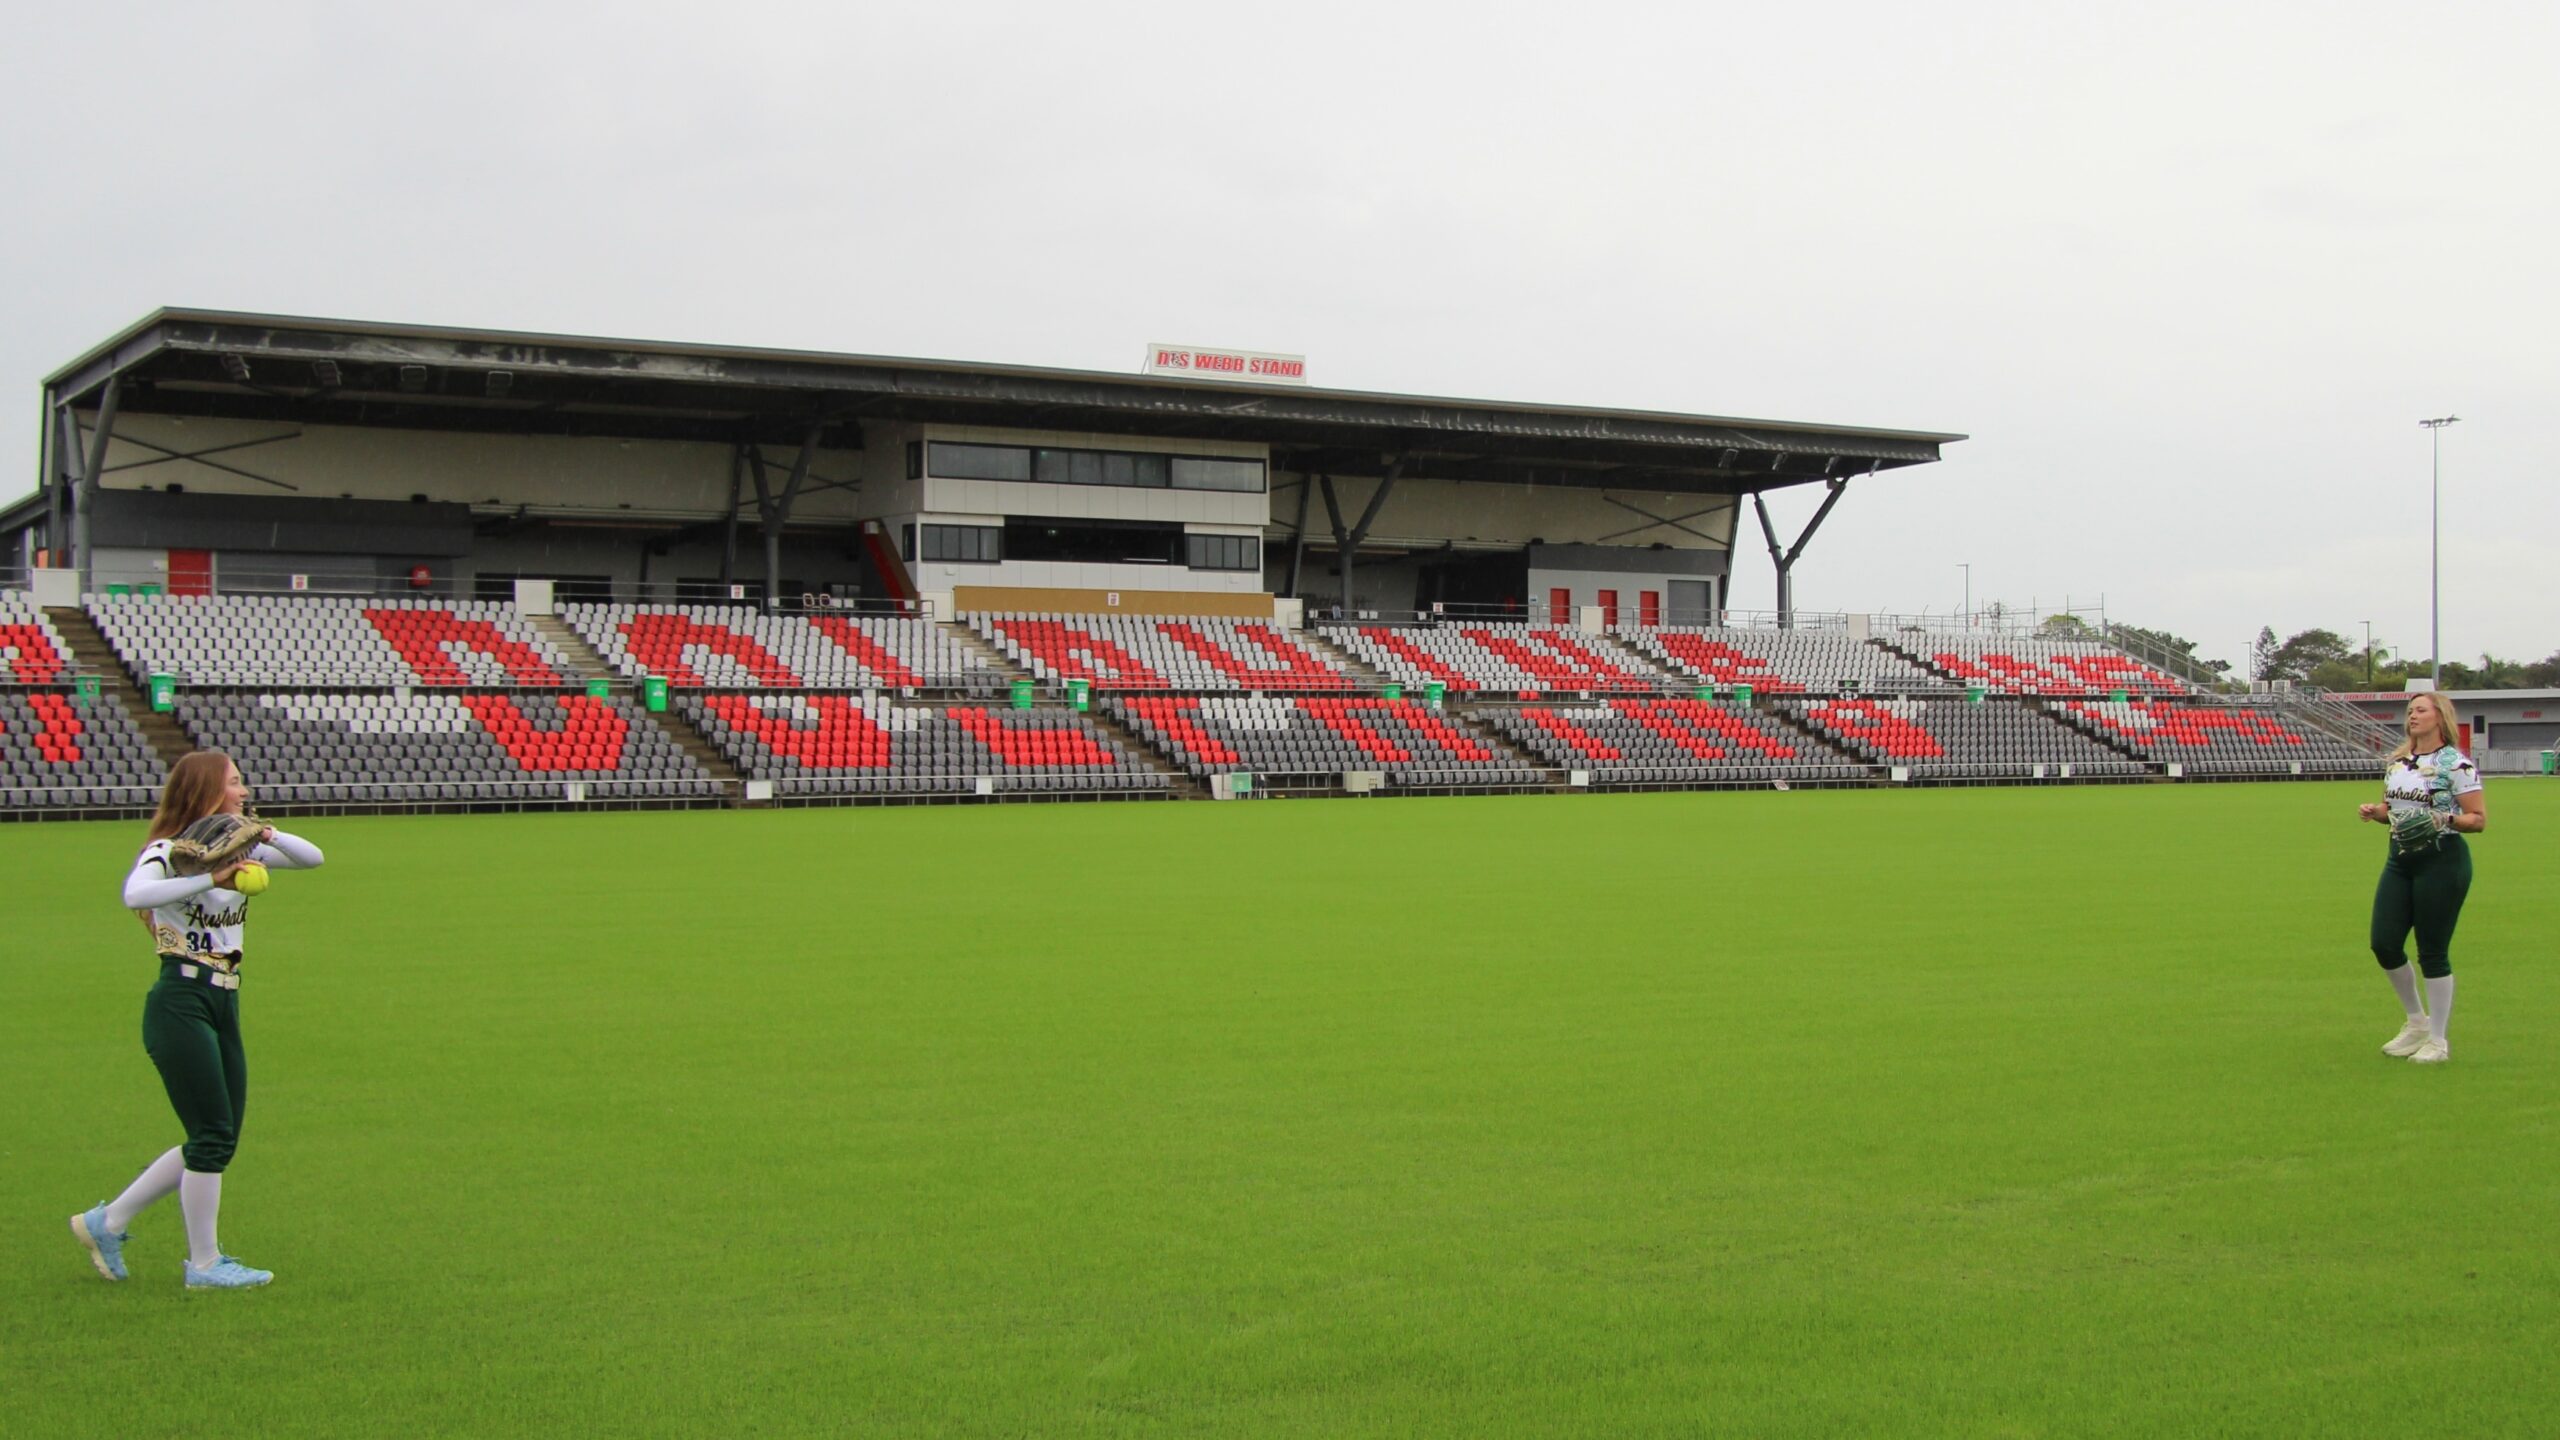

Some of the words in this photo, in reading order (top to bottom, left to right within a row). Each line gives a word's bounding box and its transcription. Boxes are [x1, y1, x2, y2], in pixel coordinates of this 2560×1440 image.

[1194, 353, 1245, 372] WEBB
[1250, 357, 1304, 378] STAND
[186, 931, 213, 953] 34
